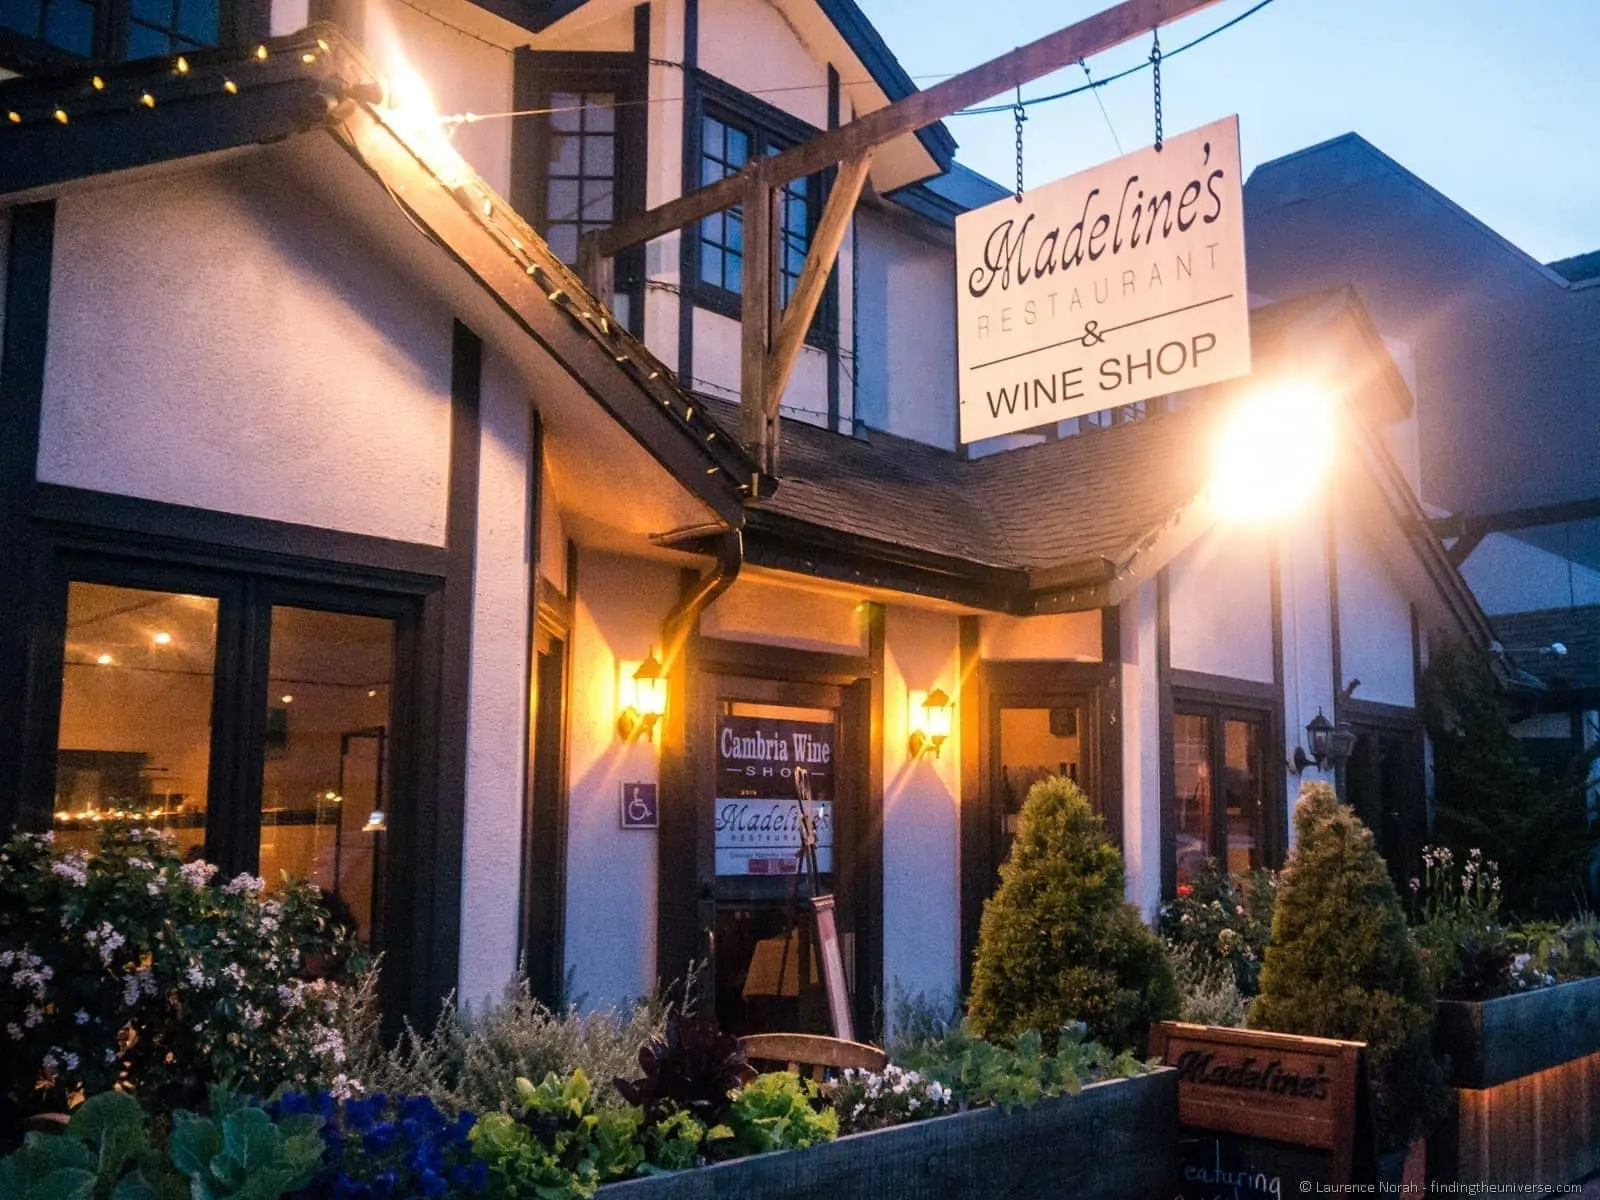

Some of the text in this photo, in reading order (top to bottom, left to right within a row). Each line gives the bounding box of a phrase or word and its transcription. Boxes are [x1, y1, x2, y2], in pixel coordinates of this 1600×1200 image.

[968, 142, 1224, 298] Madeline's
[977, 243, 1220, 340] RESTAURANT
[1081, 320, 1105, 348] &
[986, 332, 1217, 418] WINE SHOP
[721, 727, 831, 764] Cambria Wine
[746, 766, 807, 779] SHO
[715, 803, 831, 832] Madelie's
[1178, 1051, 1330, 1099] Madeline's
